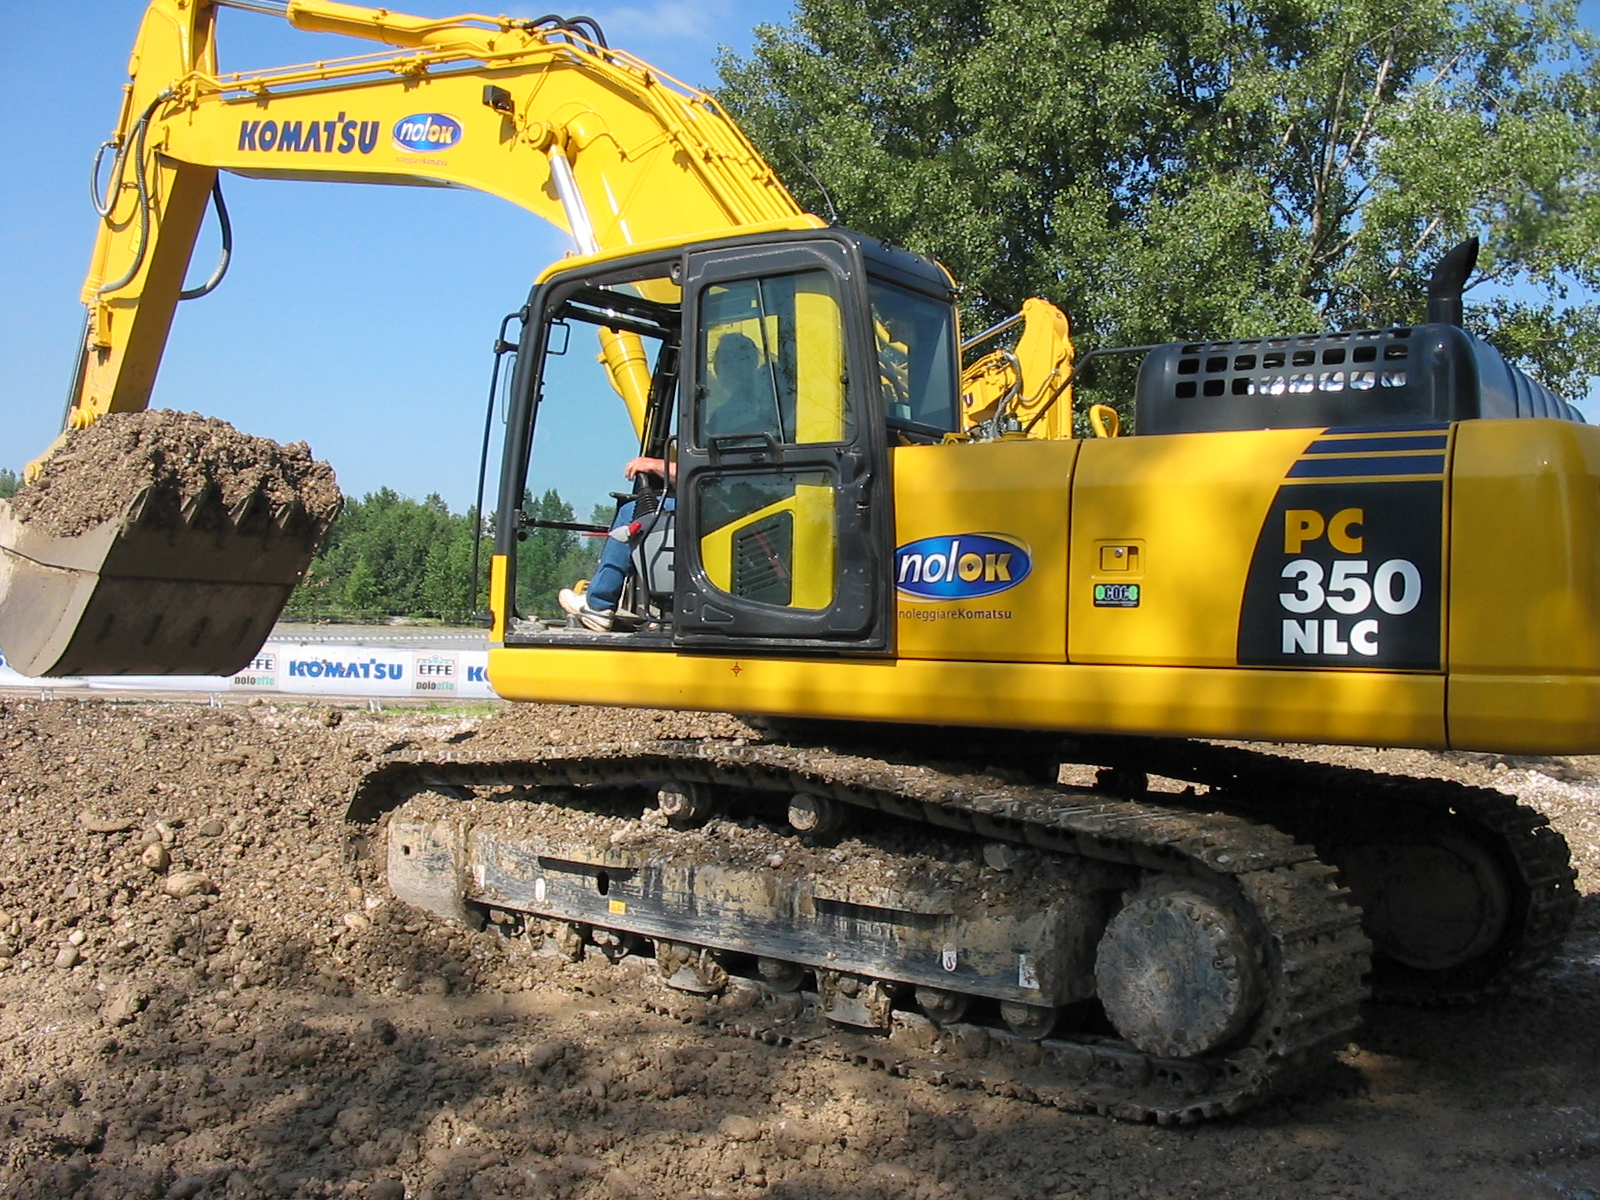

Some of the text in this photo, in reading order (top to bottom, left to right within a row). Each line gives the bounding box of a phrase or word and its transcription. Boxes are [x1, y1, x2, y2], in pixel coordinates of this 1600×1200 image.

[238, 111, 380, 155] KOMATSU
[1284, 507, 1364, 555] PC
[1279, 558, 1423, 615] 350
[899, 608, 1012, 621] noleggiareKomatsu
[1282, 618, 1379, 656] NLC
[289, 657, 404, 680] KOMATSU
[418, 664, 454, 676] EFFE
